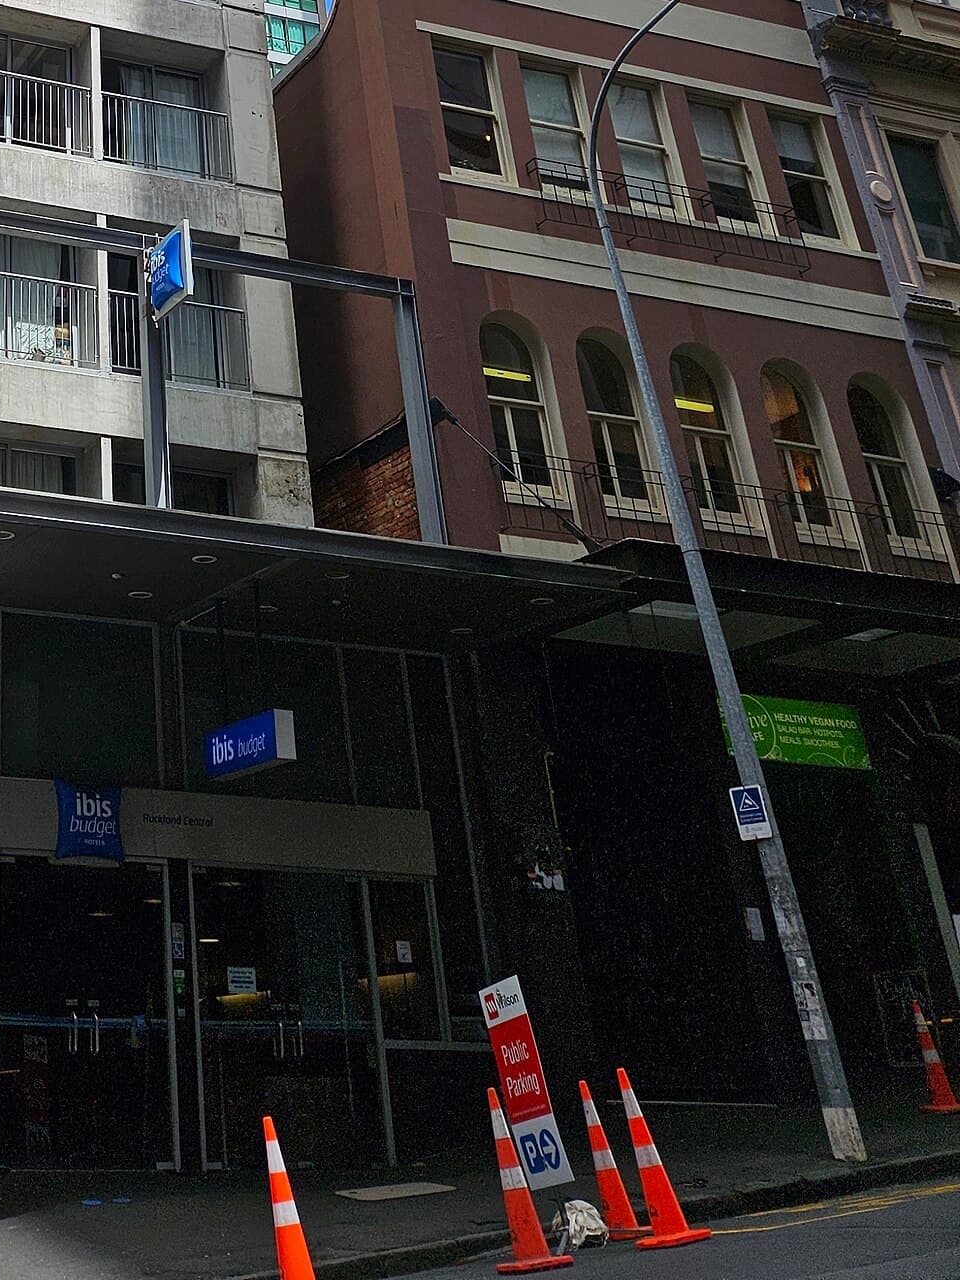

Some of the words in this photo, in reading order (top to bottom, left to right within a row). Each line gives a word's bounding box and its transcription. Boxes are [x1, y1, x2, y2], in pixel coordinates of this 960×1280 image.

[774, 712, 807, 724] HEALTHY
[808, 716, 835, 728] VEGAN
[212, 734, 234, 765] ibis
[237, 732, 266, 758] budget
[75, 791, 112, 818] ibis
[69, 815, 116, 838] budget
[183, 815, 213, 827] Central
[496, 993, 520, 1010] Wilson
[501, 1039, 530, 1067] Public
[506, 1072, 541, 1098] Parking
